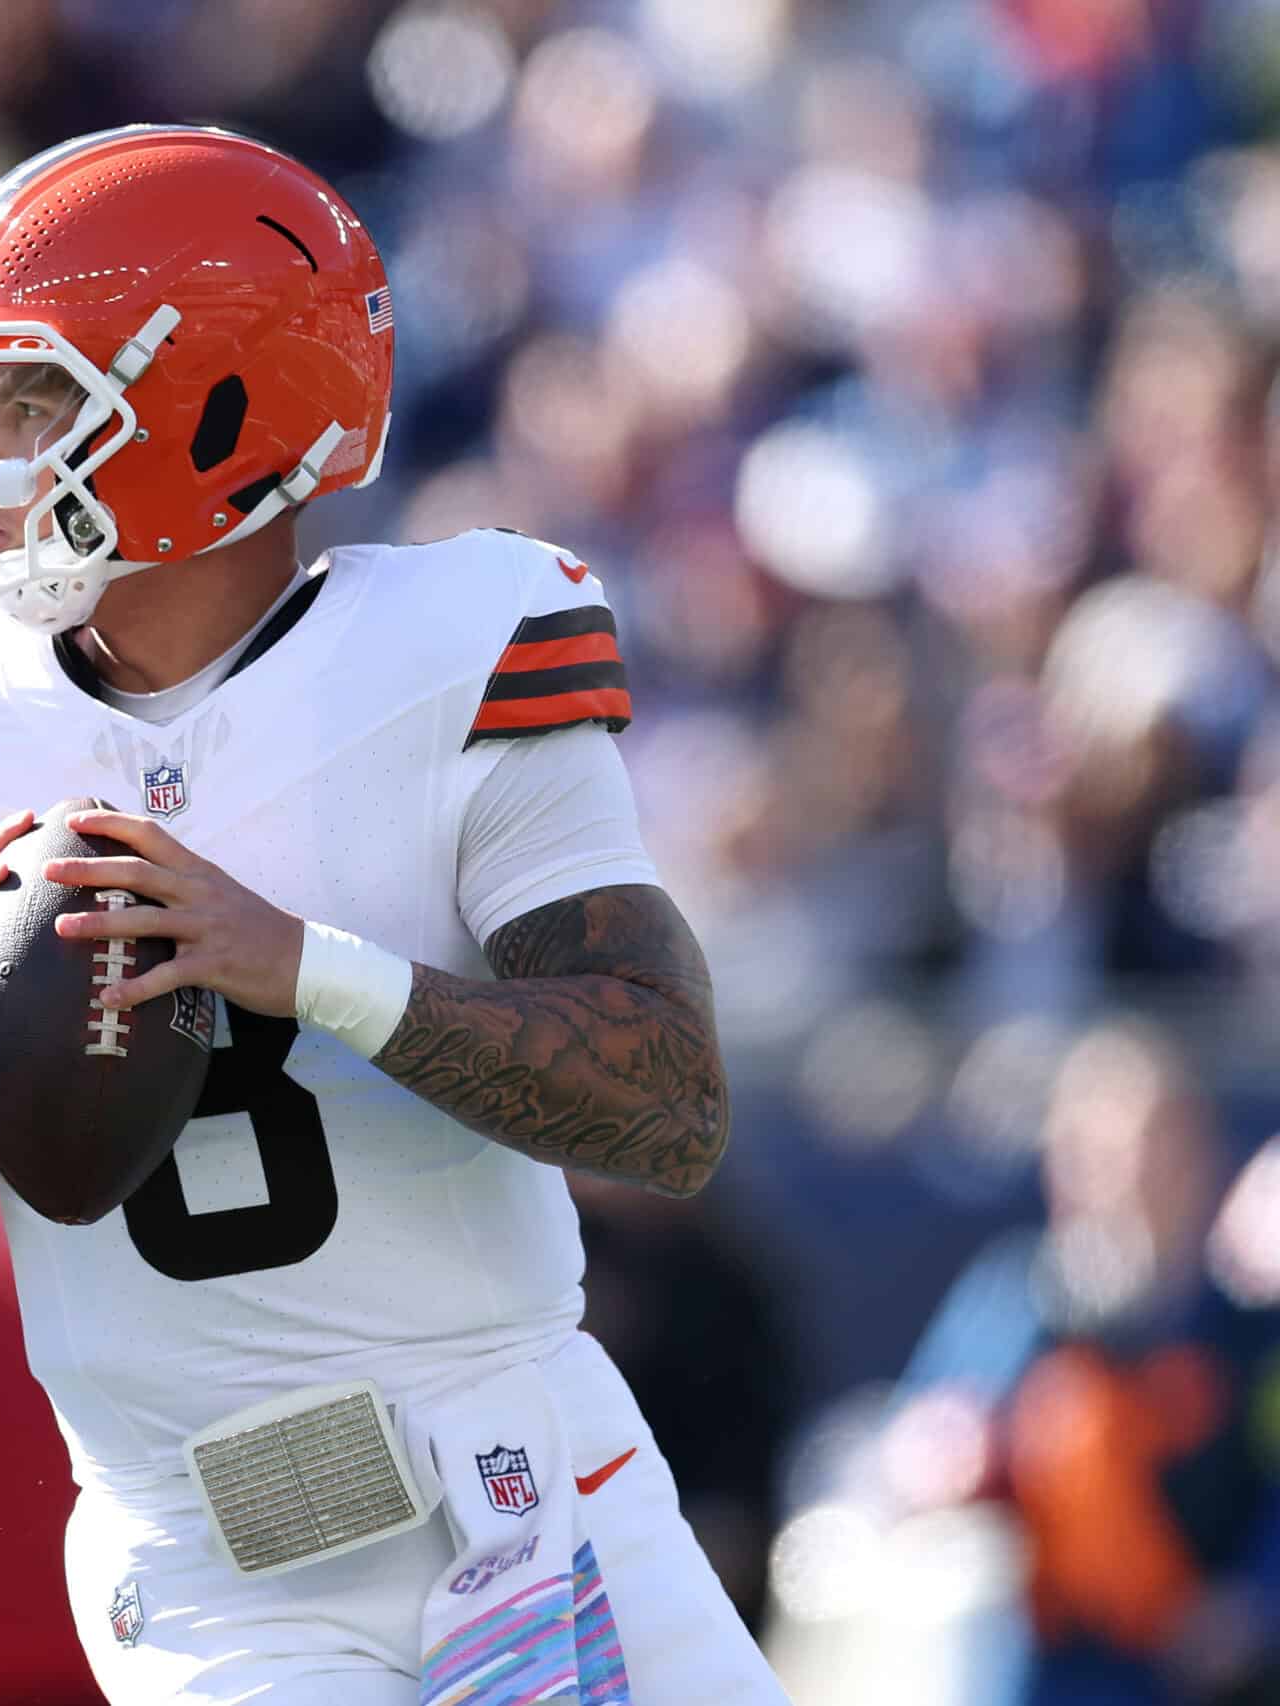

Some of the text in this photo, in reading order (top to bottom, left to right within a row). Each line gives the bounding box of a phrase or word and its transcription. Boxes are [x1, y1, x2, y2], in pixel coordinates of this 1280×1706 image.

[149, 784, 183, 811] NFL
[121, 995, 338, 1282] 8
[487, 1474, 535, 1508] NFL
[114, 1609, 138, 1638] NFL
